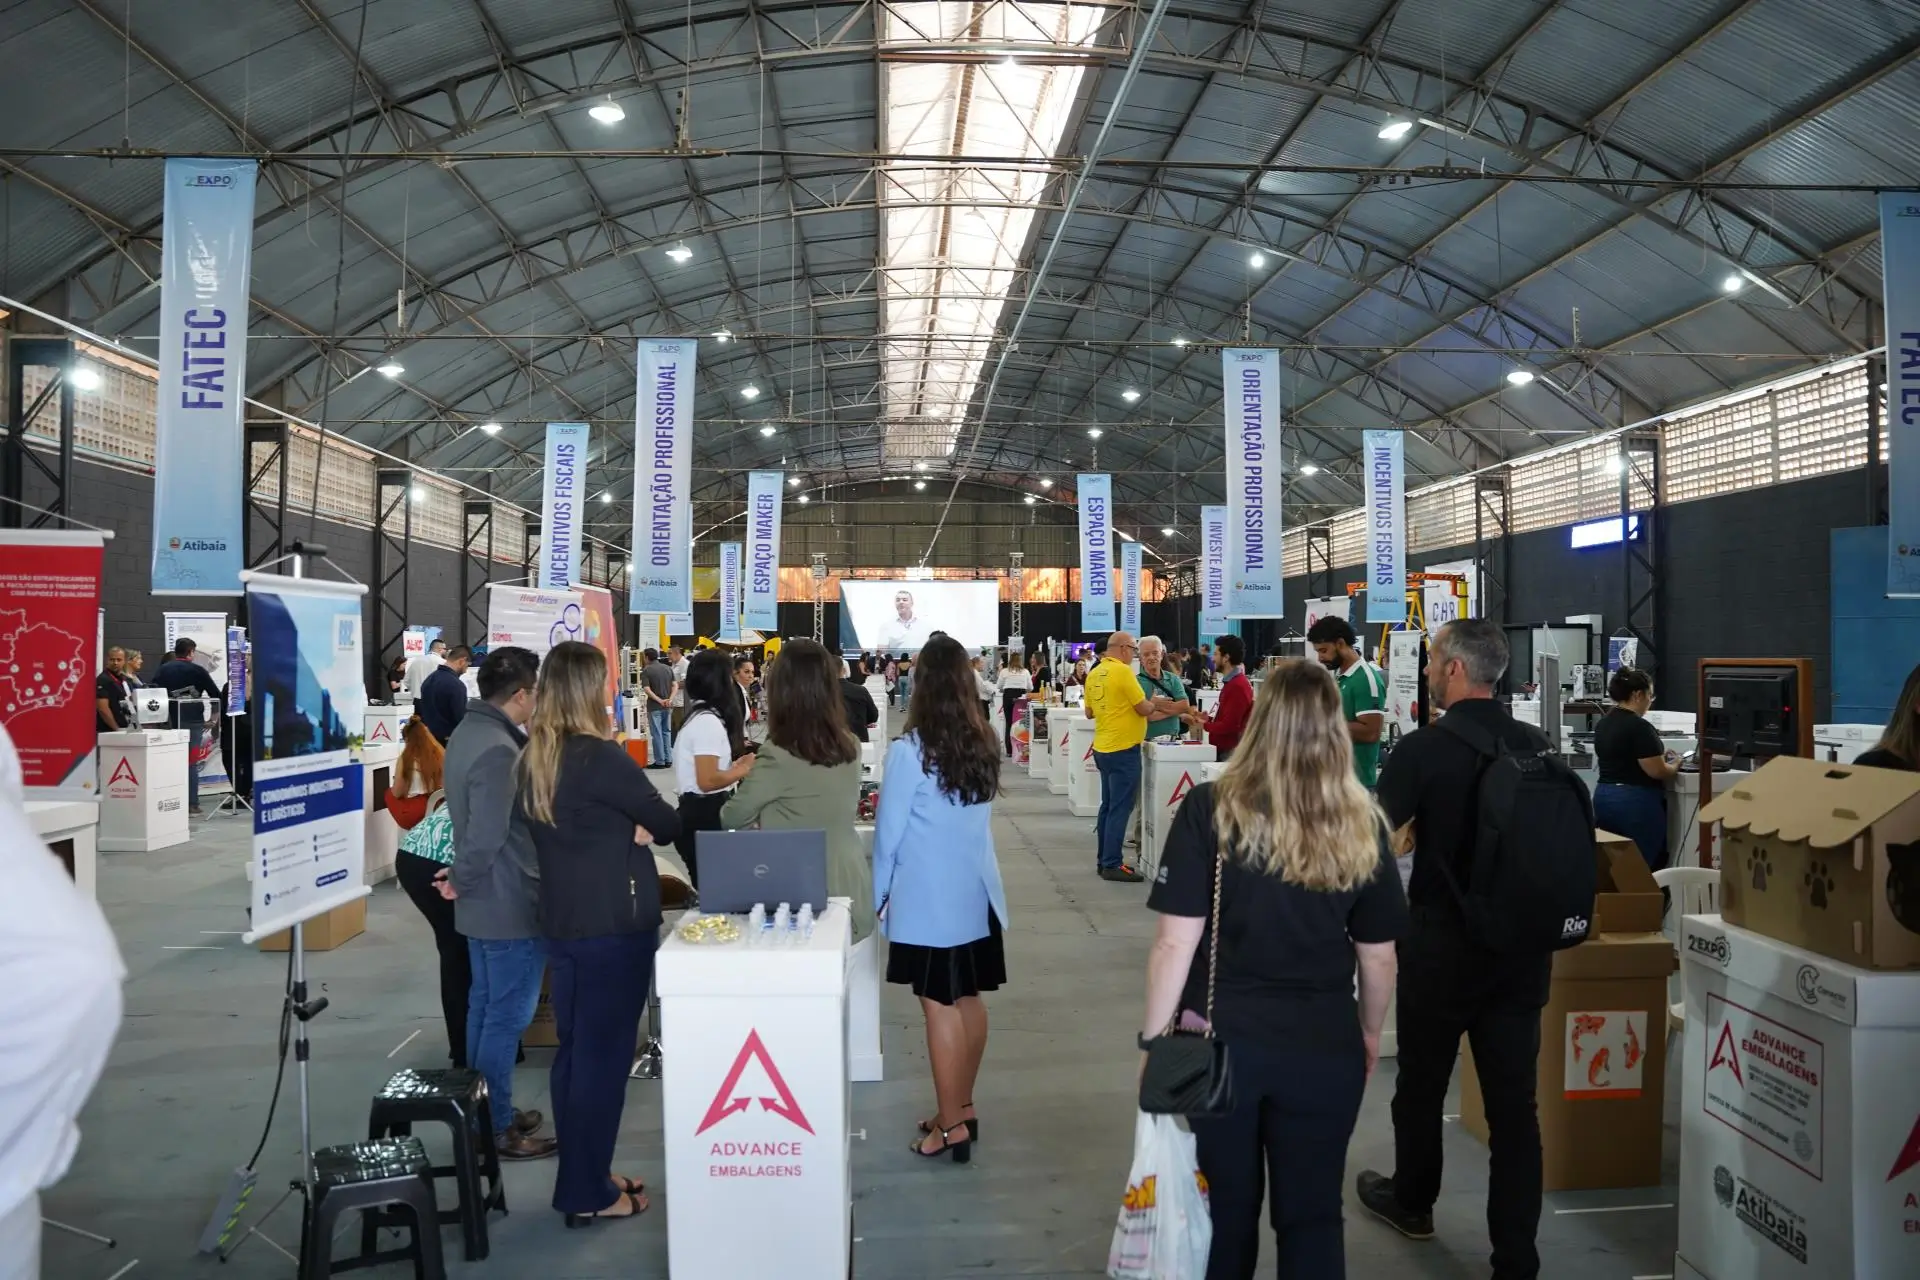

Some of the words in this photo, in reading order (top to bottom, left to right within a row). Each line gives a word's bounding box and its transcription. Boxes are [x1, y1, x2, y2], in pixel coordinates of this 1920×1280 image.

[181, 309, 227, 409] FATEC
[654, 362, 677, 469] PROFISSIONAL
[1241, 369, 1265, 462] ORIENTAÇÃO
[555, 443, 576, 499] FISCAIS
[1374, 447, 1392, 530] INCENTIVOS
[650, 473, 677, 567] ORIENTAÇÃO
[756, 493, 774, 540] MAKER
[1085, 497, 1105, 547] ESPAÇO
[1244, 466, 1263, 574] PROFISSIONAL
[182, 539, 227, 551] Atibaia
[550, 502, 572, 587] INCENTIVOS
[1209, 521, 1222, 565] INVESTE
[1376, 534, 1394, 586] FISCAIS
[649, 578, 678, 587] Atibaia
[754, 544, 775, 594] ESPAÇO
[1089, 550, 1107, 596] MAKER
[1209, 566, 1222, 609] ATIBAIA
[1243, 583, 1271, 591] Atibaia
[1563, 915, 1588, 933] Rio
[1741, 1039, 1819, 1087] EMBALAGENS
[1752, 1029, 1807, 1064] ADVANCE
[709, 1165, 803, 1178] EMBALAGENS
[710, 1142, 802, 1156] ADVANCE
[1736, 1187, 1808, 1252] Atibaia
